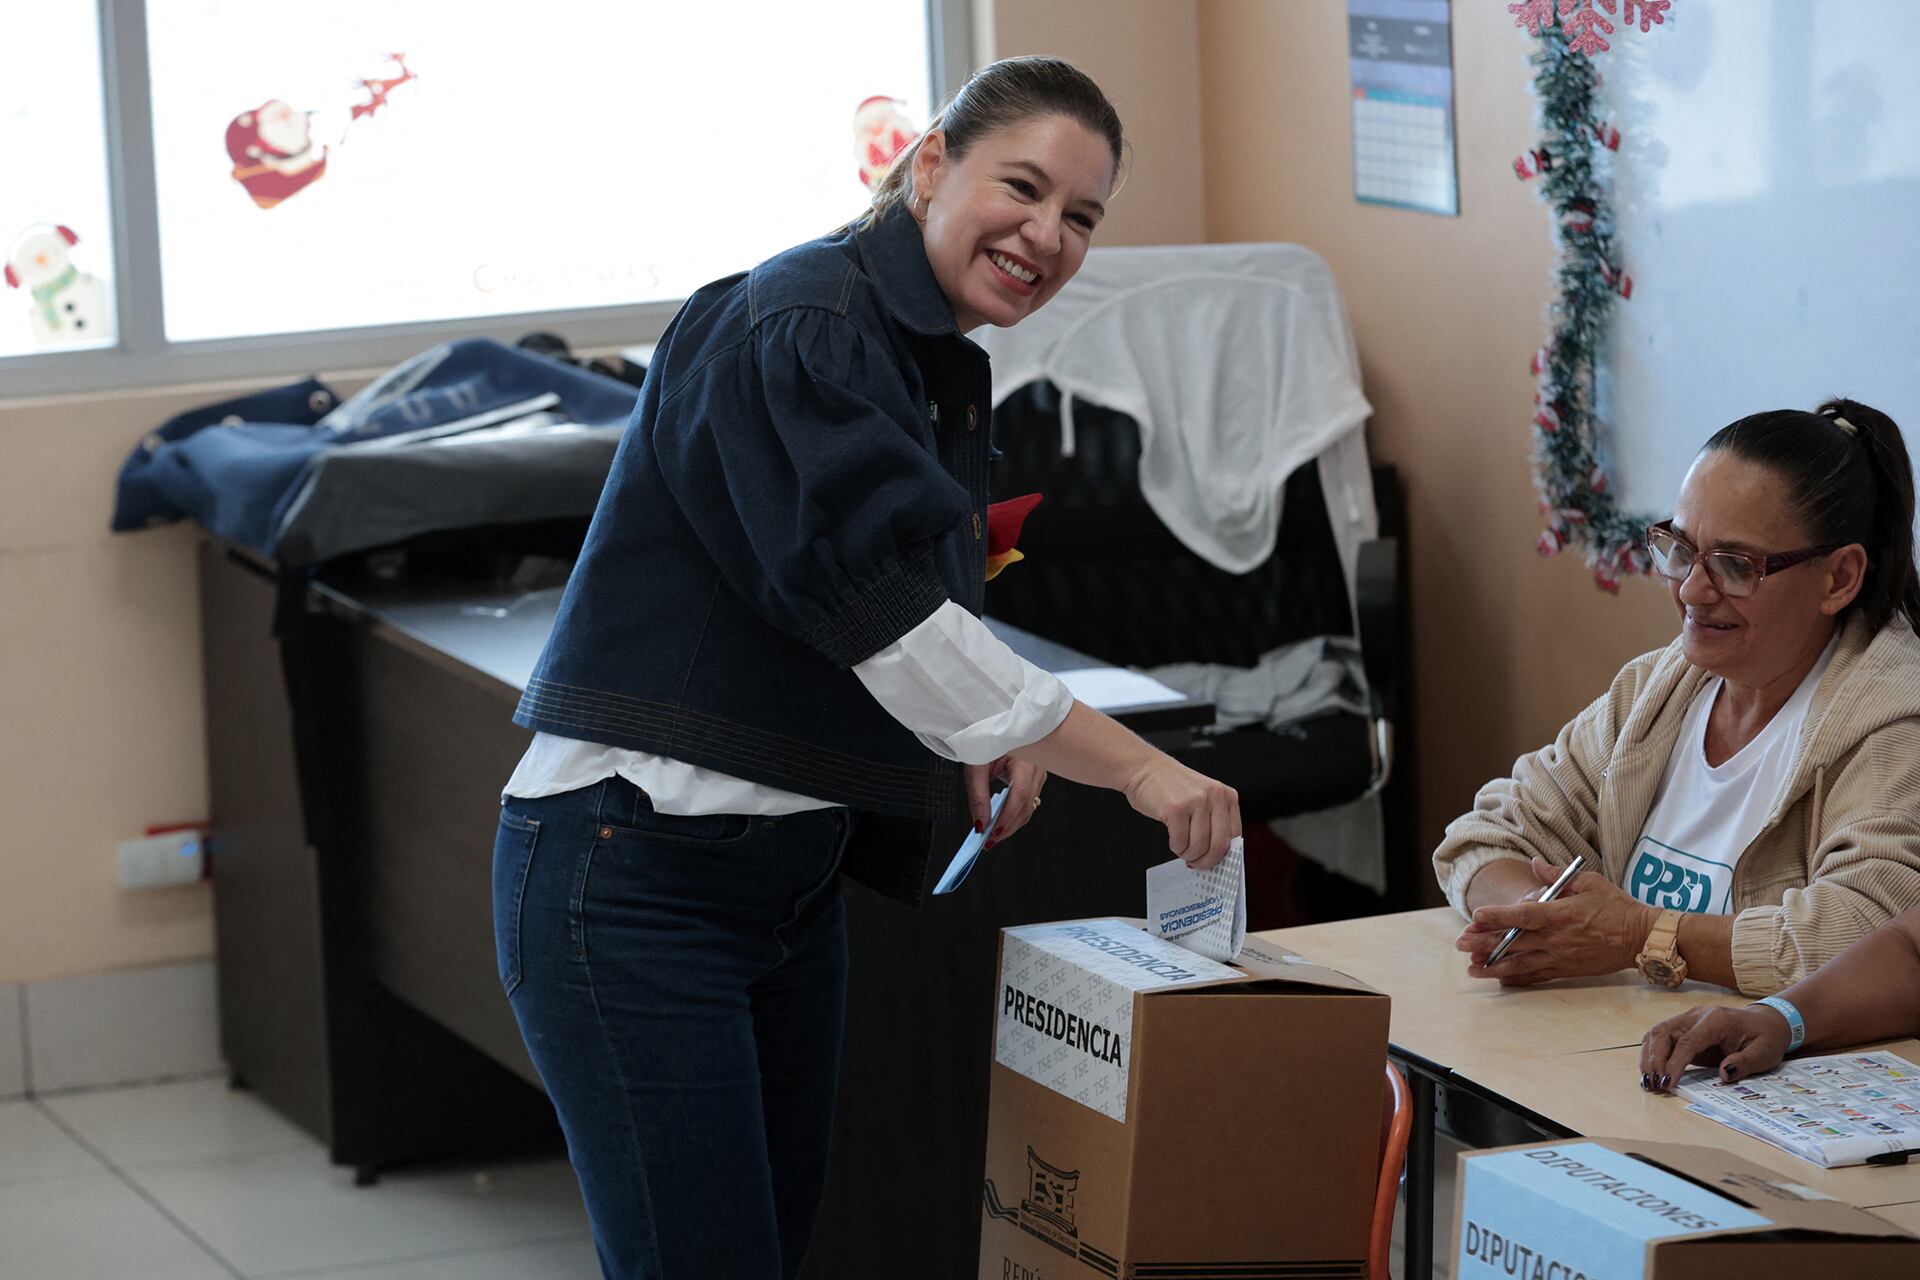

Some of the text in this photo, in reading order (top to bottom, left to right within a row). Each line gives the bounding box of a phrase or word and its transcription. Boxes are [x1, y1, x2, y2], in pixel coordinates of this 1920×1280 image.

[1160, 903, 1223, 933] PRESIDENCIA
[1055, 926, 1196, 980] PRESIDENCIA
[1004, 984, 1122, 1068] PRESIDENCIA
[1524, 1150, 1718, 1229] DIPUTACIONES
